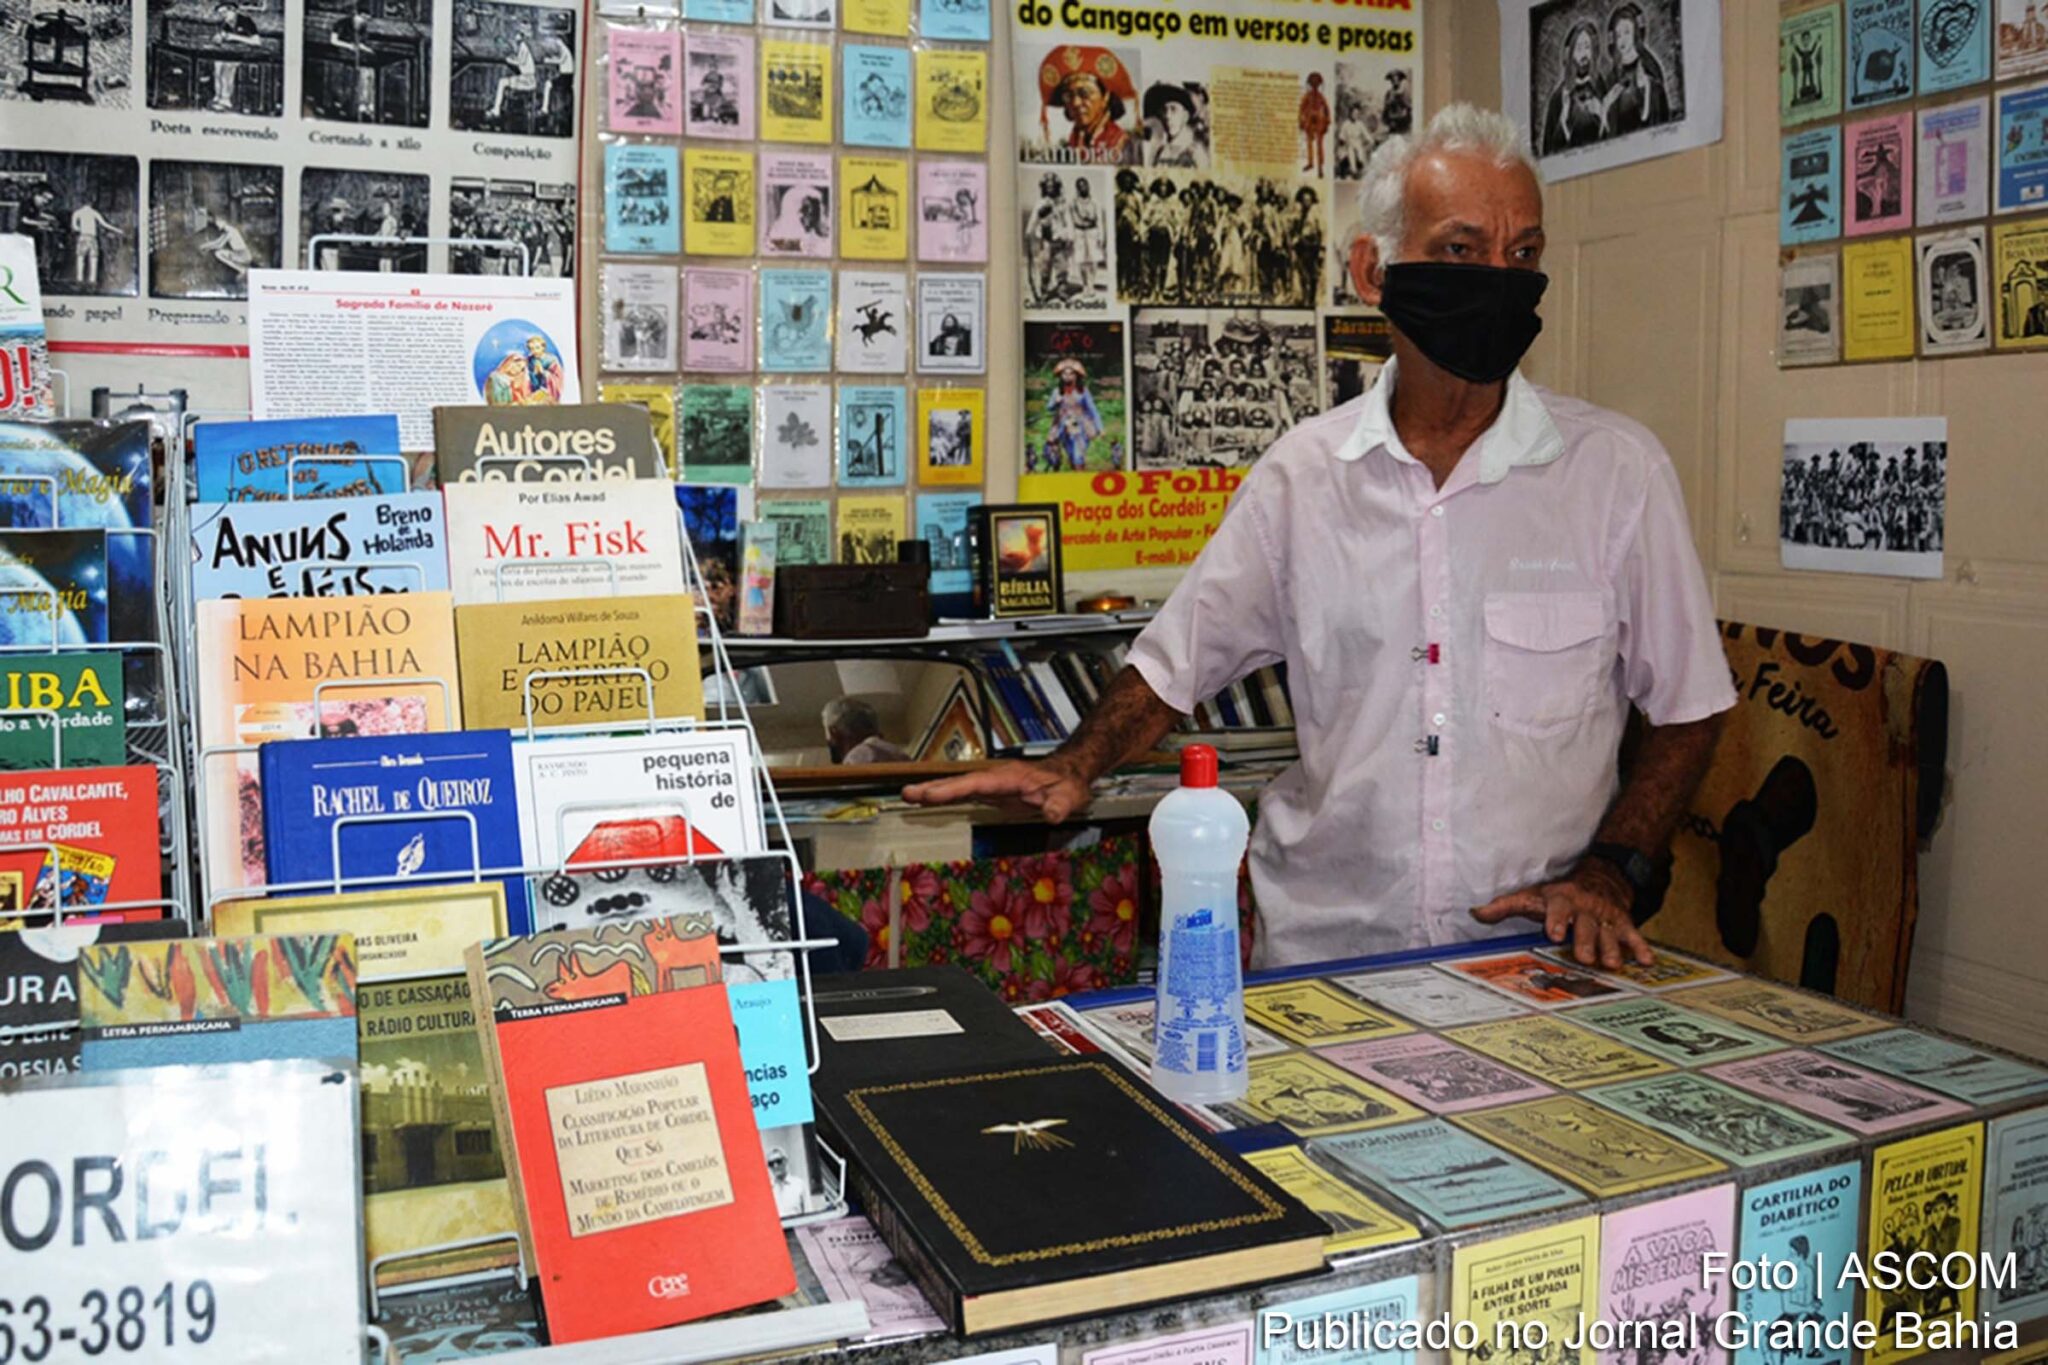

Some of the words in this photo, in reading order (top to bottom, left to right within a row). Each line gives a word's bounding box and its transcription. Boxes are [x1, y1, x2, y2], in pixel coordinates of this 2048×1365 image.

[1018, 2, 1053, 26] do
[1061, 0, 1181, 39] Cangaço
[1189, 13, 1228, 36] em
[1235, 19, 1309, 44] versos
[1316, 24, 1331, 45] e
[1338, 26, 1413, 53] prosas
[150, 119, 192, 134] Poeta
[202, 126, 279, 141] escrevendo
[308, 129, 373, 148] Cortando
[472, 141, 552, 161] Composição
[84, 306, 123, 323] papel
[435, 300, 450, 311] de
[474, 422, 617, 456] Autores
[57, 467, 134, 504] Magia
[1091, 471, 1127, 497] O
[519, 493, 540, 505] Por
[542, 492, 571, 504] Elias
[574, 491, 606, 503] Awad
[376, 504, 433, 527] Breno
[1063, 501, 1113, 525] Praça
[1117, 501, 1145, 519] dos
[212, 511, 352, 570] ANUNS
[363, 527, 435, 555] Holanda
[482, 523, 551, 559] Mr.
[564, 518, 649, 557] Fisk
[1105, 528, 1118, 543] de
[1122, 528, 1145, 542] Arte
[1149, 525, 1194, 542] Popular
[267, 566, 287, 590] E
[1000, 579, 1051, 595] BÍBLIA
[240, 604, 412, 642] LAMPIÃO
[600, 610, 613, 621] de
[614, 609, 640, 621] Souza
[518, 632, 650, 665] LAMPIÃO
[233, 653, 290, 682] NA
[303, 647, 422, 680] BAHIA
[502, 668, 519, 692] E
[520, 691, 564, 717] DO
[1748, 662, 1840, 740] Feira
[19, 719, 31, 731] a
[643, 750, 731, 773] pequena
[29, 782, 129, 803] CAVALCANTE,
[656, 770, 733, 791] história
[312, 784, 386, 818] RACHEL
[393, 790, 412, 811] DE
[418, 776, 494, 811] QUEIROZ
[711, 791, 736, 810] de
[22, 804, 69, 824] ALVES
[47, 821, 103, 840] CORDEL
[374, 932, 419, 946] OLIVEIRA
[373, 989, 394, 1008] DE
[398, 980, 473, 1006] CASSAÇÃO
[511, 1008, 543, 1020] TERRA
[543, 996, 622, 1014] PERNAMBUCANA
[102, 1026, 138, 1039] LETRA
[138, 1020, 232, 1036] PERNAMBUCANA
[367, 1015, 413, 1038] RÁDIO
[647, 1095, 700, 1116] POPULAR
[558, 1136, 574, 1150] DA
[576, 1121, 644, 1147] LITERATURA
[646, 1119, 662, 1133] DE
[664, 1109, 711, 1129] CORDEL
[616, 1145, 643, 1166] QUE
[569, 1170, 639, 1197] MARKETING
[640, 1166, 664, 1181] DOS
[614, 1182, 670, 1206] REMÉDIO
[690, 1177, 701, 1190] O
[1751, 1181, 1824, 1213] CARTILHA
[1828, 1174, 1852, 1193] DO
[625, 1206, 642, 1222] DA
[1760, 1195, 1841, 1228] DIABÉTICO
[1472, 1289, 1480, 1301] A
[1481, 1281, 1510, 1299] FILHA
[1512, 1276, 1526, 1290] DE
[1528, 1272, 1545, 1287] UM
[1546, 1262, 1582, 1281] PIRATA
[1482, 1293, 1516, 1312] ENTRE
[1518, 1290, 1527, 1301] A
[1528, 1280, 1569, 1299] ESPADA
[1507, 1306, 1515, 1317] A
[1517, 1298, 1552, 1316] SORTE
